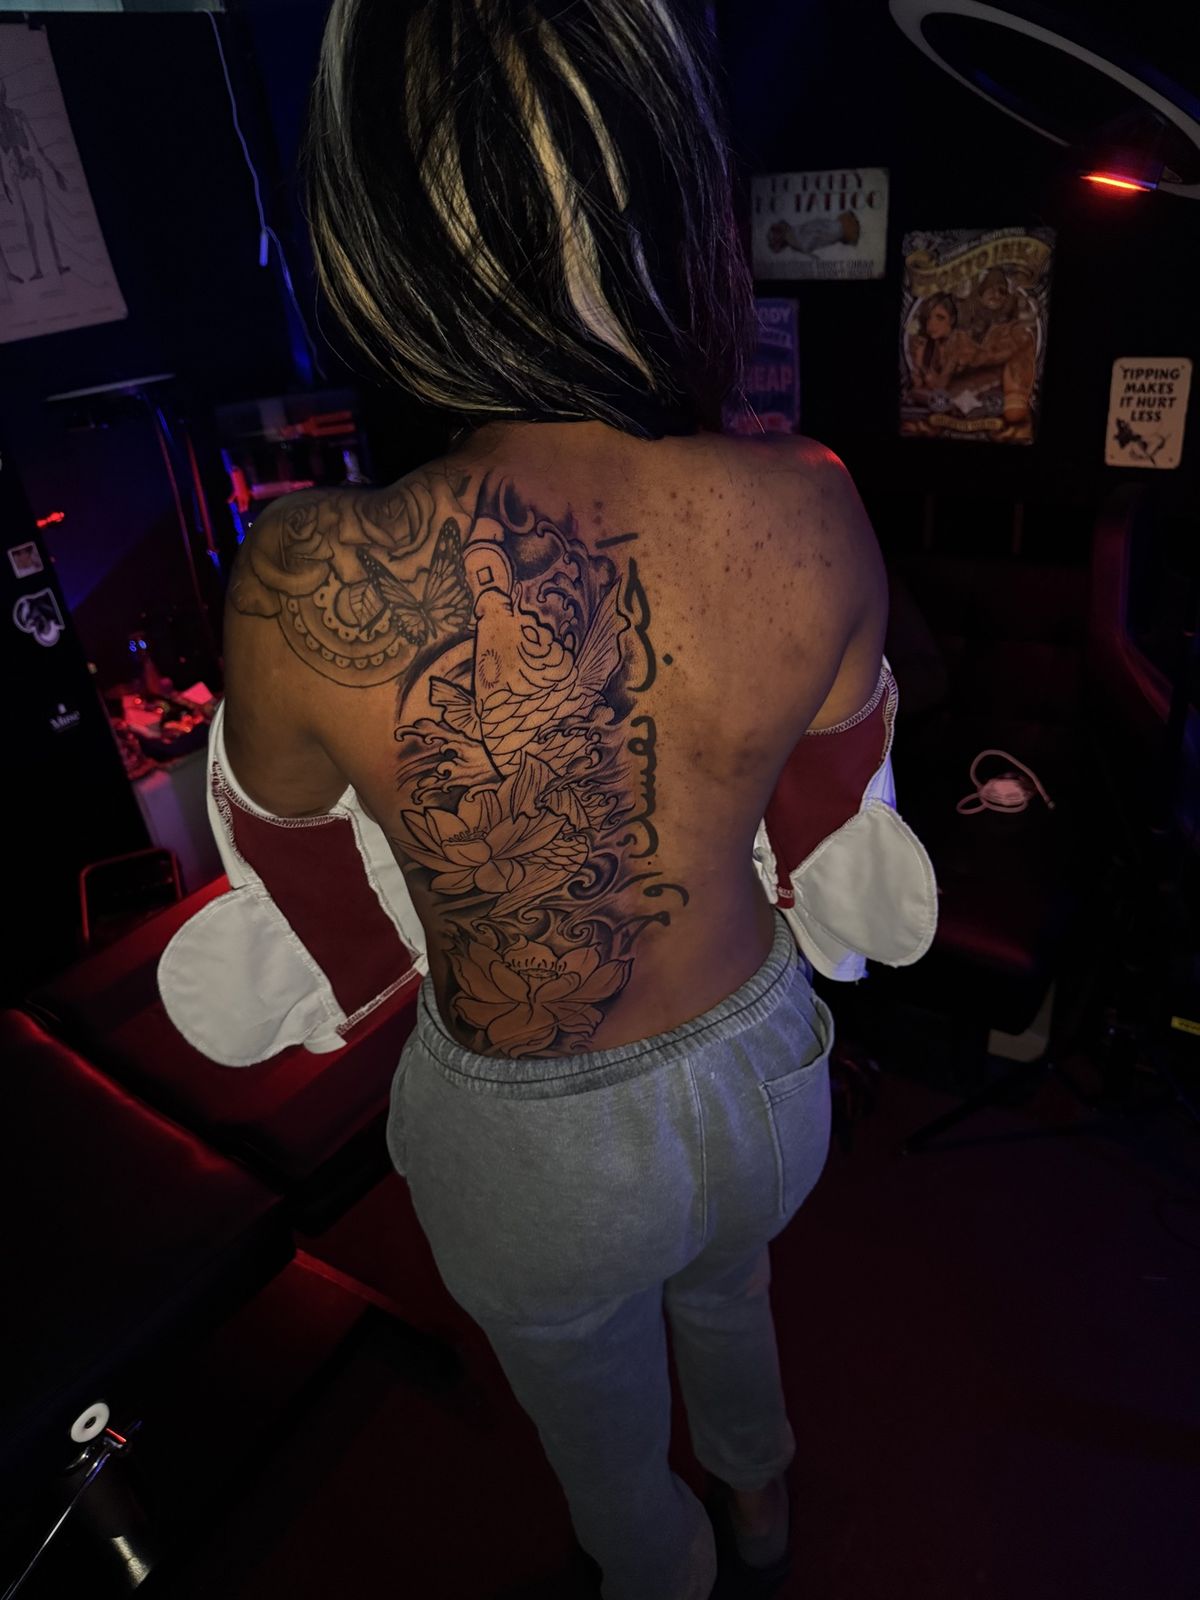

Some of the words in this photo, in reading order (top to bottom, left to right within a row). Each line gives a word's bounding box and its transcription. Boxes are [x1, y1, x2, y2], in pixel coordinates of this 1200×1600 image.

[1121, 367, 1180, 380] TIPPING
[1124, 382, 1174, 394] MAKES
[1119, 396, 1134, 408] IT
[1136, 396, 1176, 408] HURT
[1130, 410, 1161, 422] LESS
